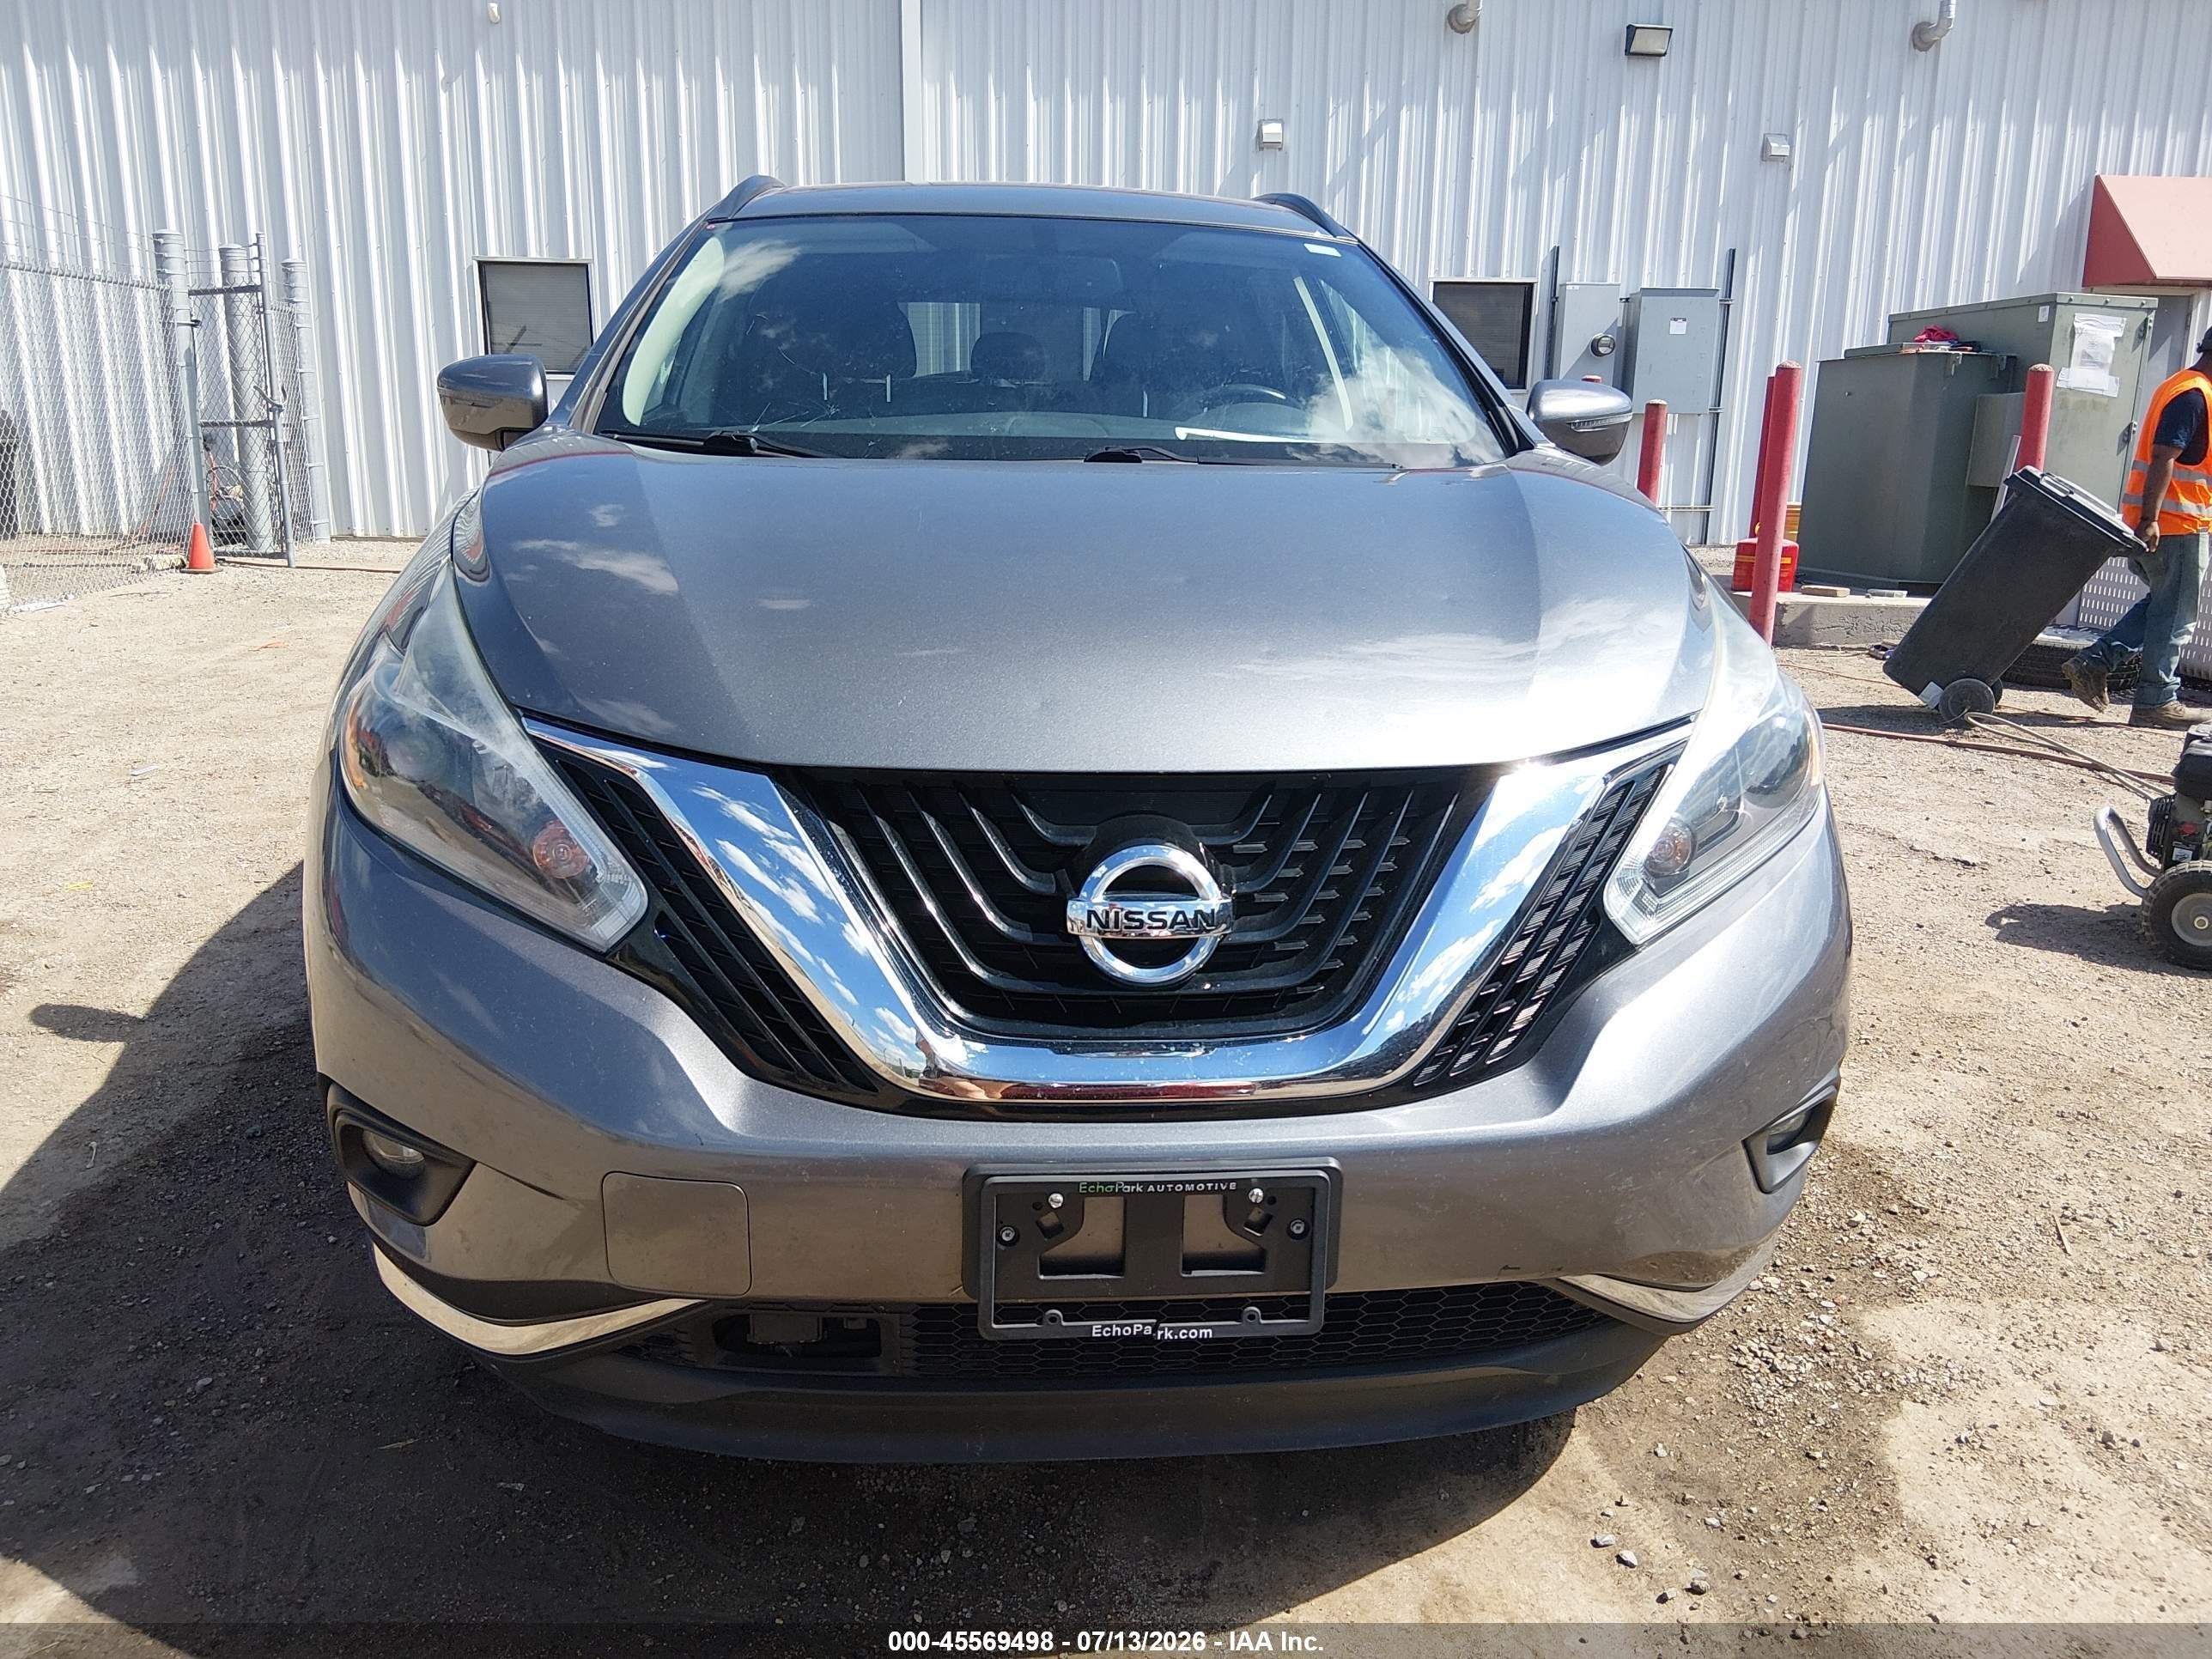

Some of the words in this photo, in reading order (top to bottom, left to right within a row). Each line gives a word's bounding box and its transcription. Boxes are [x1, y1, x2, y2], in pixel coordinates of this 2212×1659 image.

[1086, 908, 1216, 930] NISSAN
[1079, 1182, 1144, 1194] EchoPark
[1147, 1182, 1237, 1193] AUTOMOTIVE
